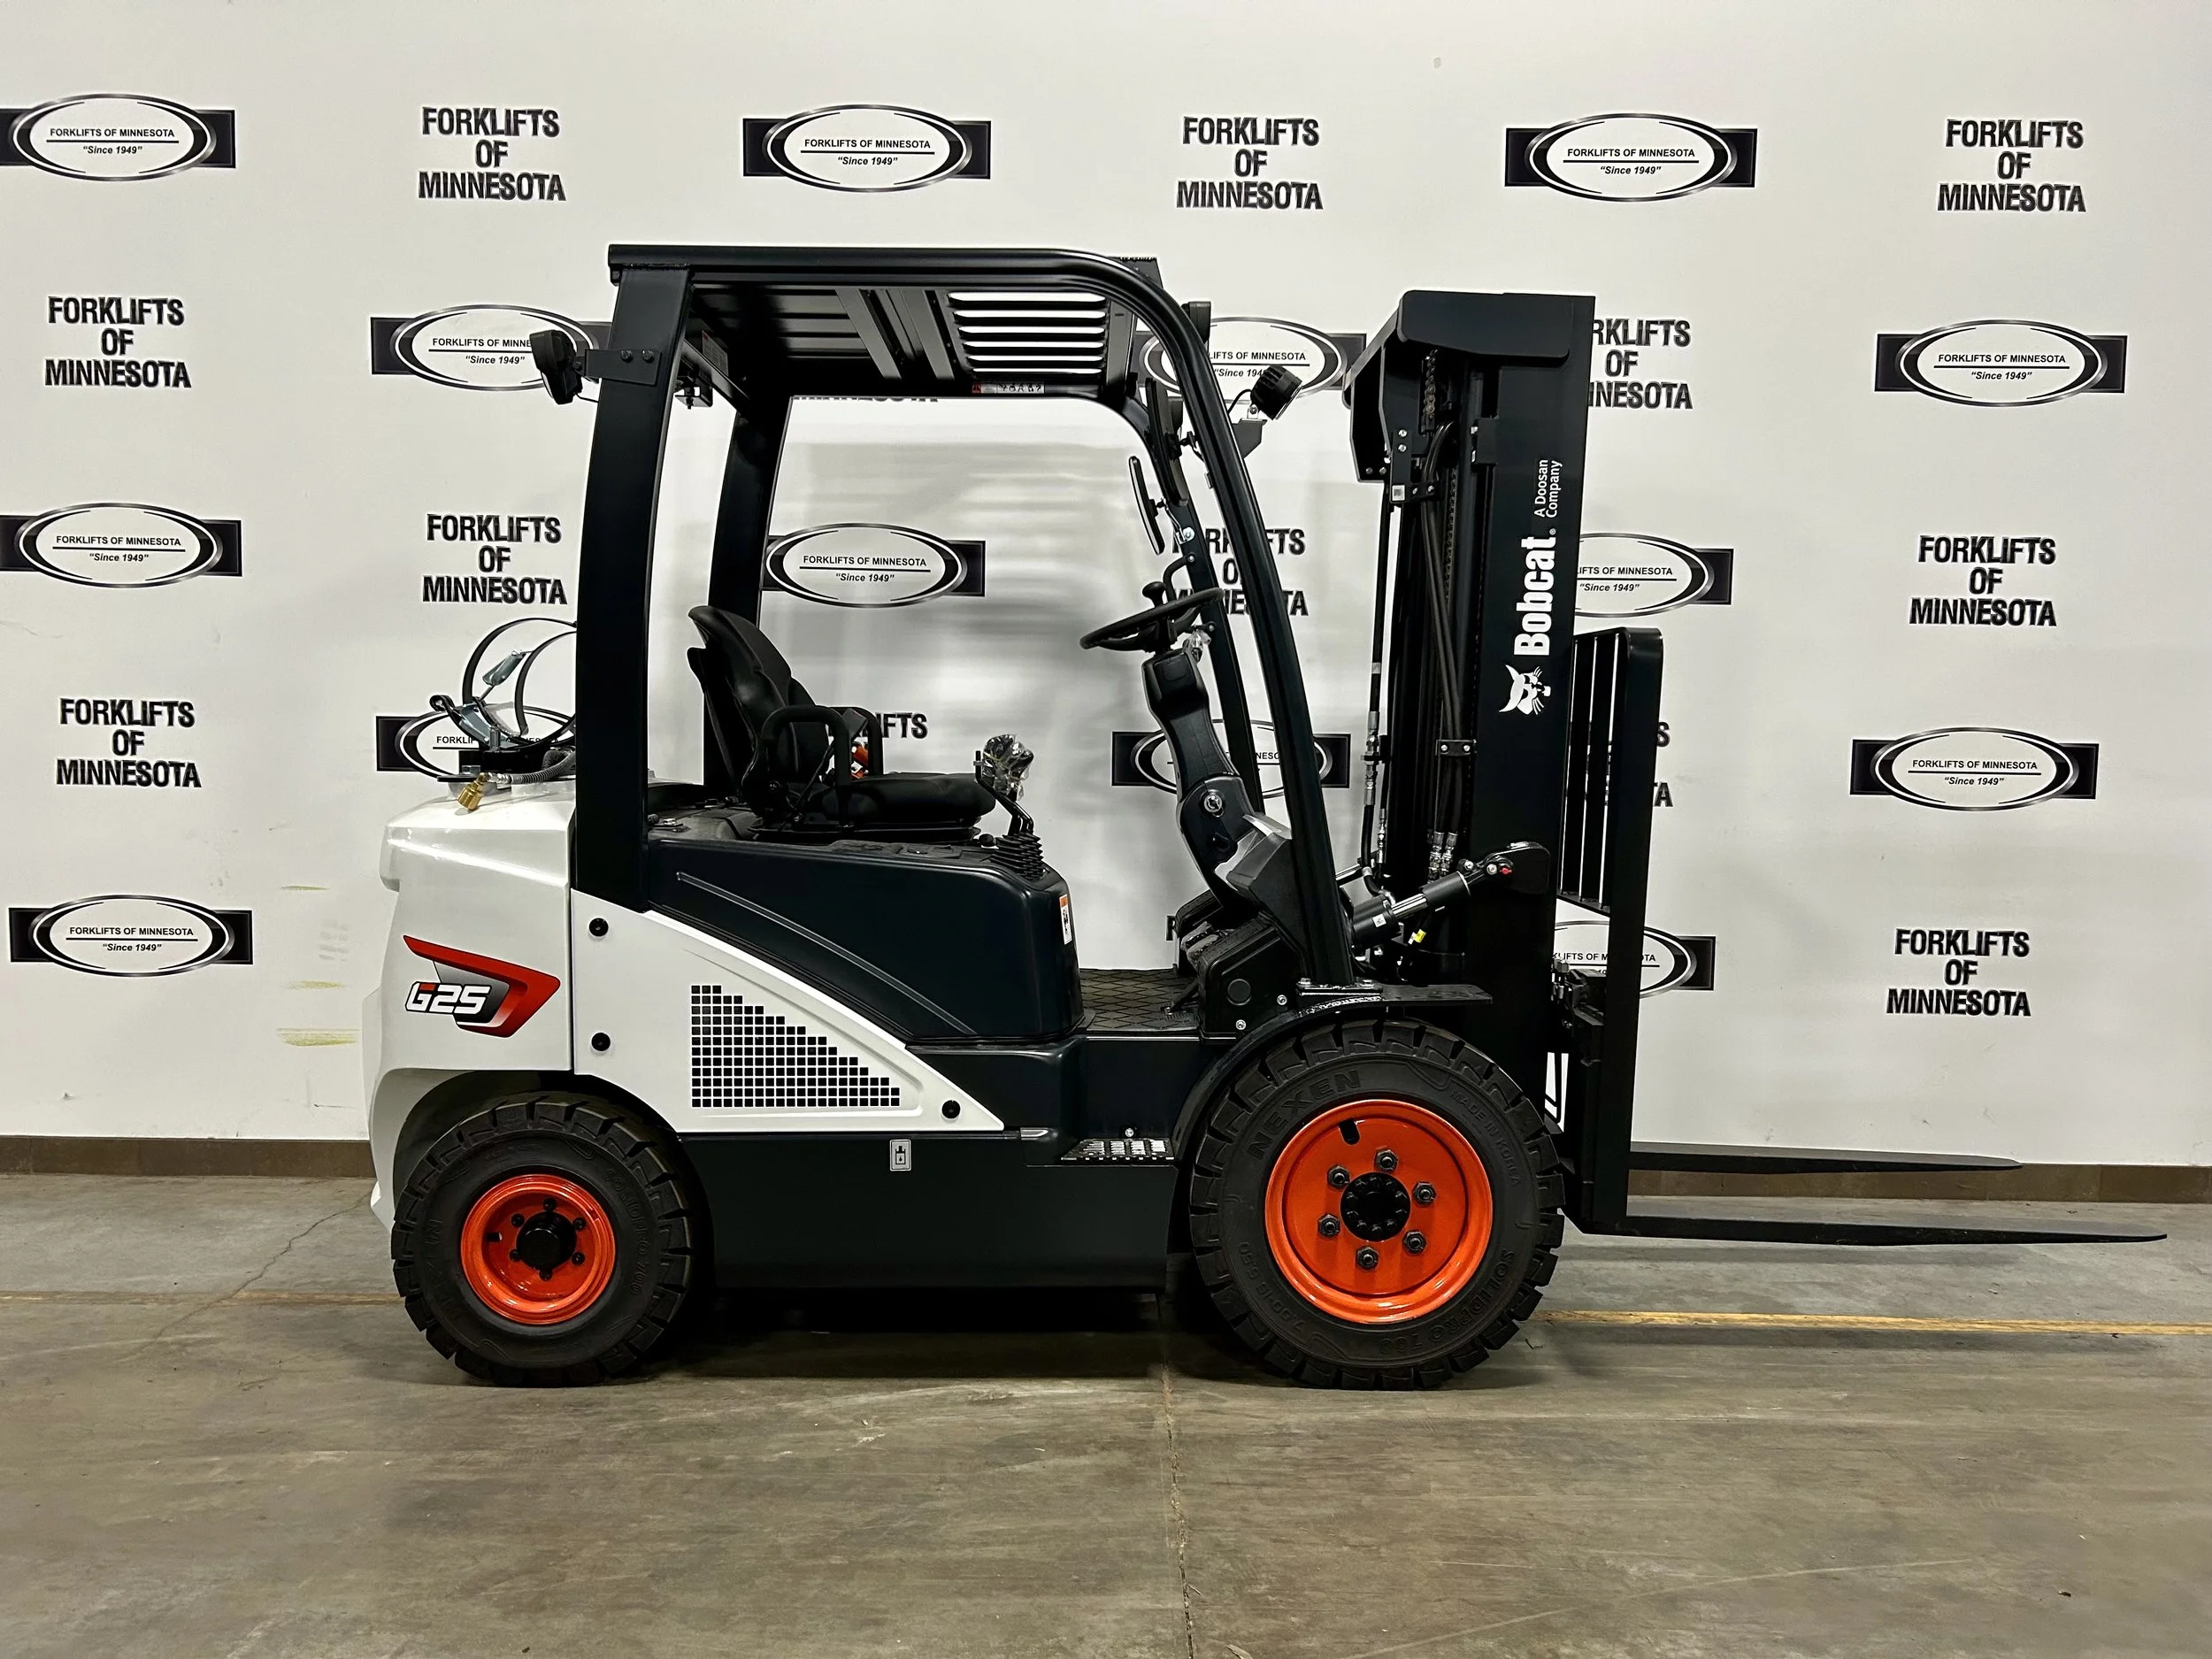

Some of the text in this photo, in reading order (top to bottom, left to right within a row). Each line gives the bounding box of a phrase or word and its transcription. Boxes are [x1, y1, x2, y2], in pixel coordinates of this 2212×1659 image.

[50, 127, 174, 136] FORKLIFTS OF MINNESOTA
[422, 106, 560, 138] FORKLIFTS
[1182, 116, 1320, 147] FORKLIFTS
[1945, 119, 2084, 149] FORKLIFTS
[475, 139, 509, 168] OF
[804, 138, 931, 148] FORKLIFTS OF MINNESOTA
[1623, 148, 1636, 157] OF
[1639, 148, 1694, 157] MINNESOTA
[1233, 149, 1268, 177] OF
[1997, 150, 2032, 180] OF
[418, 171, 566, 202] MINNESOTA
[1176, 180, 1324, 211] MINNESOTA
[1937, 182, 2086, 212] MINNESOTA
[48, 296, 184, 326] FORKLIFTS
[101, 327, 134, 356] OF
[432, 337, 485, 347] FORKLIFTS
[502, 339, 532, 348] MINNE
[1593, 318, 1692, 348] RKLIFTS
[1235, 351, 1248, 360] OF
[1250, 351, 1307, 361] MINNESOTA
[1604, 349, 1640, 378] OF
[1993, 354, 2007, 363] OF
[2009, 354, 2065, 363] MINNESOTA
[44, 358, 192, 388] MINNESOTA
[1246, 368, 1265, 378] 194
[1589, 380, 1694, 410] NESOTA
[1533, 459, 1549, 518] A Doosan
[1545, 459, 1563, 518] Company
[56, 535, 180, 545] FORKLIFTS OF MINNESOTA
[426, 513, 562, 544] FORKLIFTS
[478, 545, 511, 573] OF
[803, 555, 926, 565] FORKLIFTS OF MINNESOTA
[1918, 534, 2056, 565] FORKLIFTS
[1601, 566, 1616, 575] OF
[1617, 566, 1673, 575] MINNESOTA
[1969, 566, 2003, 595] OF
[422, 575, 568, 605] MINNESOTA
[1513, 536, 1557, 657] Bobcat
[1909, 597, 2057, 626] MINNESOTA
[60, 697, 195, 728] FORKLIFTS
[111, 729, 145, 757] OF
[56, 758, 202, 788] MINNESOTA
[1912, 759, 2037, 769] FORKLIFTS OF MINNESOTA
[123, 926, 136, 935] OF
[139, 926, 193, 935] MINNESOTA
[1893, 928, 2030, 957] FORKLIFTS
[1945, 958, 1978, 986] OF
[406, 981, 492, 1015] G25
[1886, 987, 2032, 1018] MINNESOTA
[1244, 1068, 1361, 1160] NEXEN
[1448, 1087, 1488, 1123] MADE
[1482, 1118, 1500, 1136] IN
[601, 1166, 649, 1256] SOLIDPRO
[1425, 1246, 1519, 1345] SOLIDPRO
